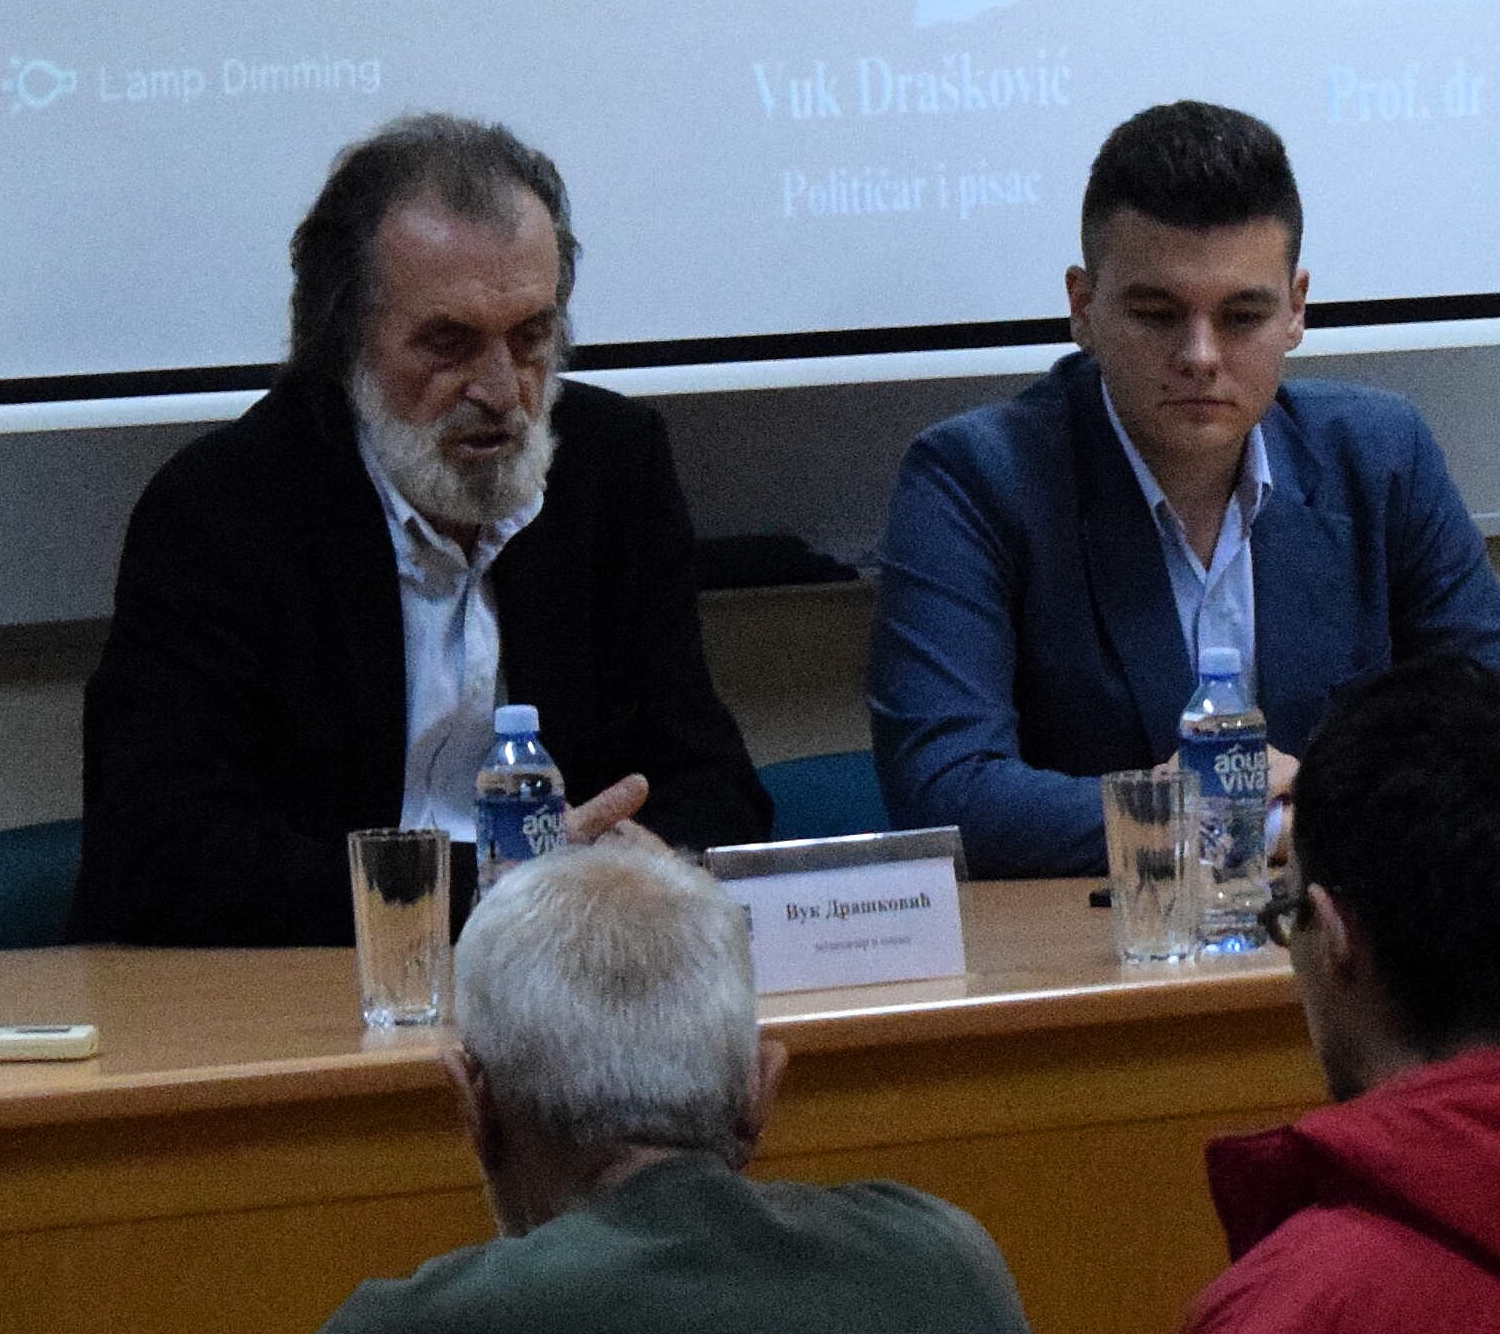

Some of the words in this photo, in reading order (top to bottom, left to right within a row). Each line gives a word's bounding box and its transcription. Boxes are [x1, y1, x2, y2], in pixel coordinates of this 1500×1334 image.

[99, 64, 206, 105] Lamp
[223, 53, 383, 98] Dimming
[751, 58, 843, 119] Vuk
[857, 45, 1074, 115] Drašković
[1327, 60, 1430, 125] Prof.
[1443, 55, 1486, 117] dr
[782, 166, 927, 219] Političar
[937, 162, 951, 209] i
[959, 158, 1044, 221] pisac
